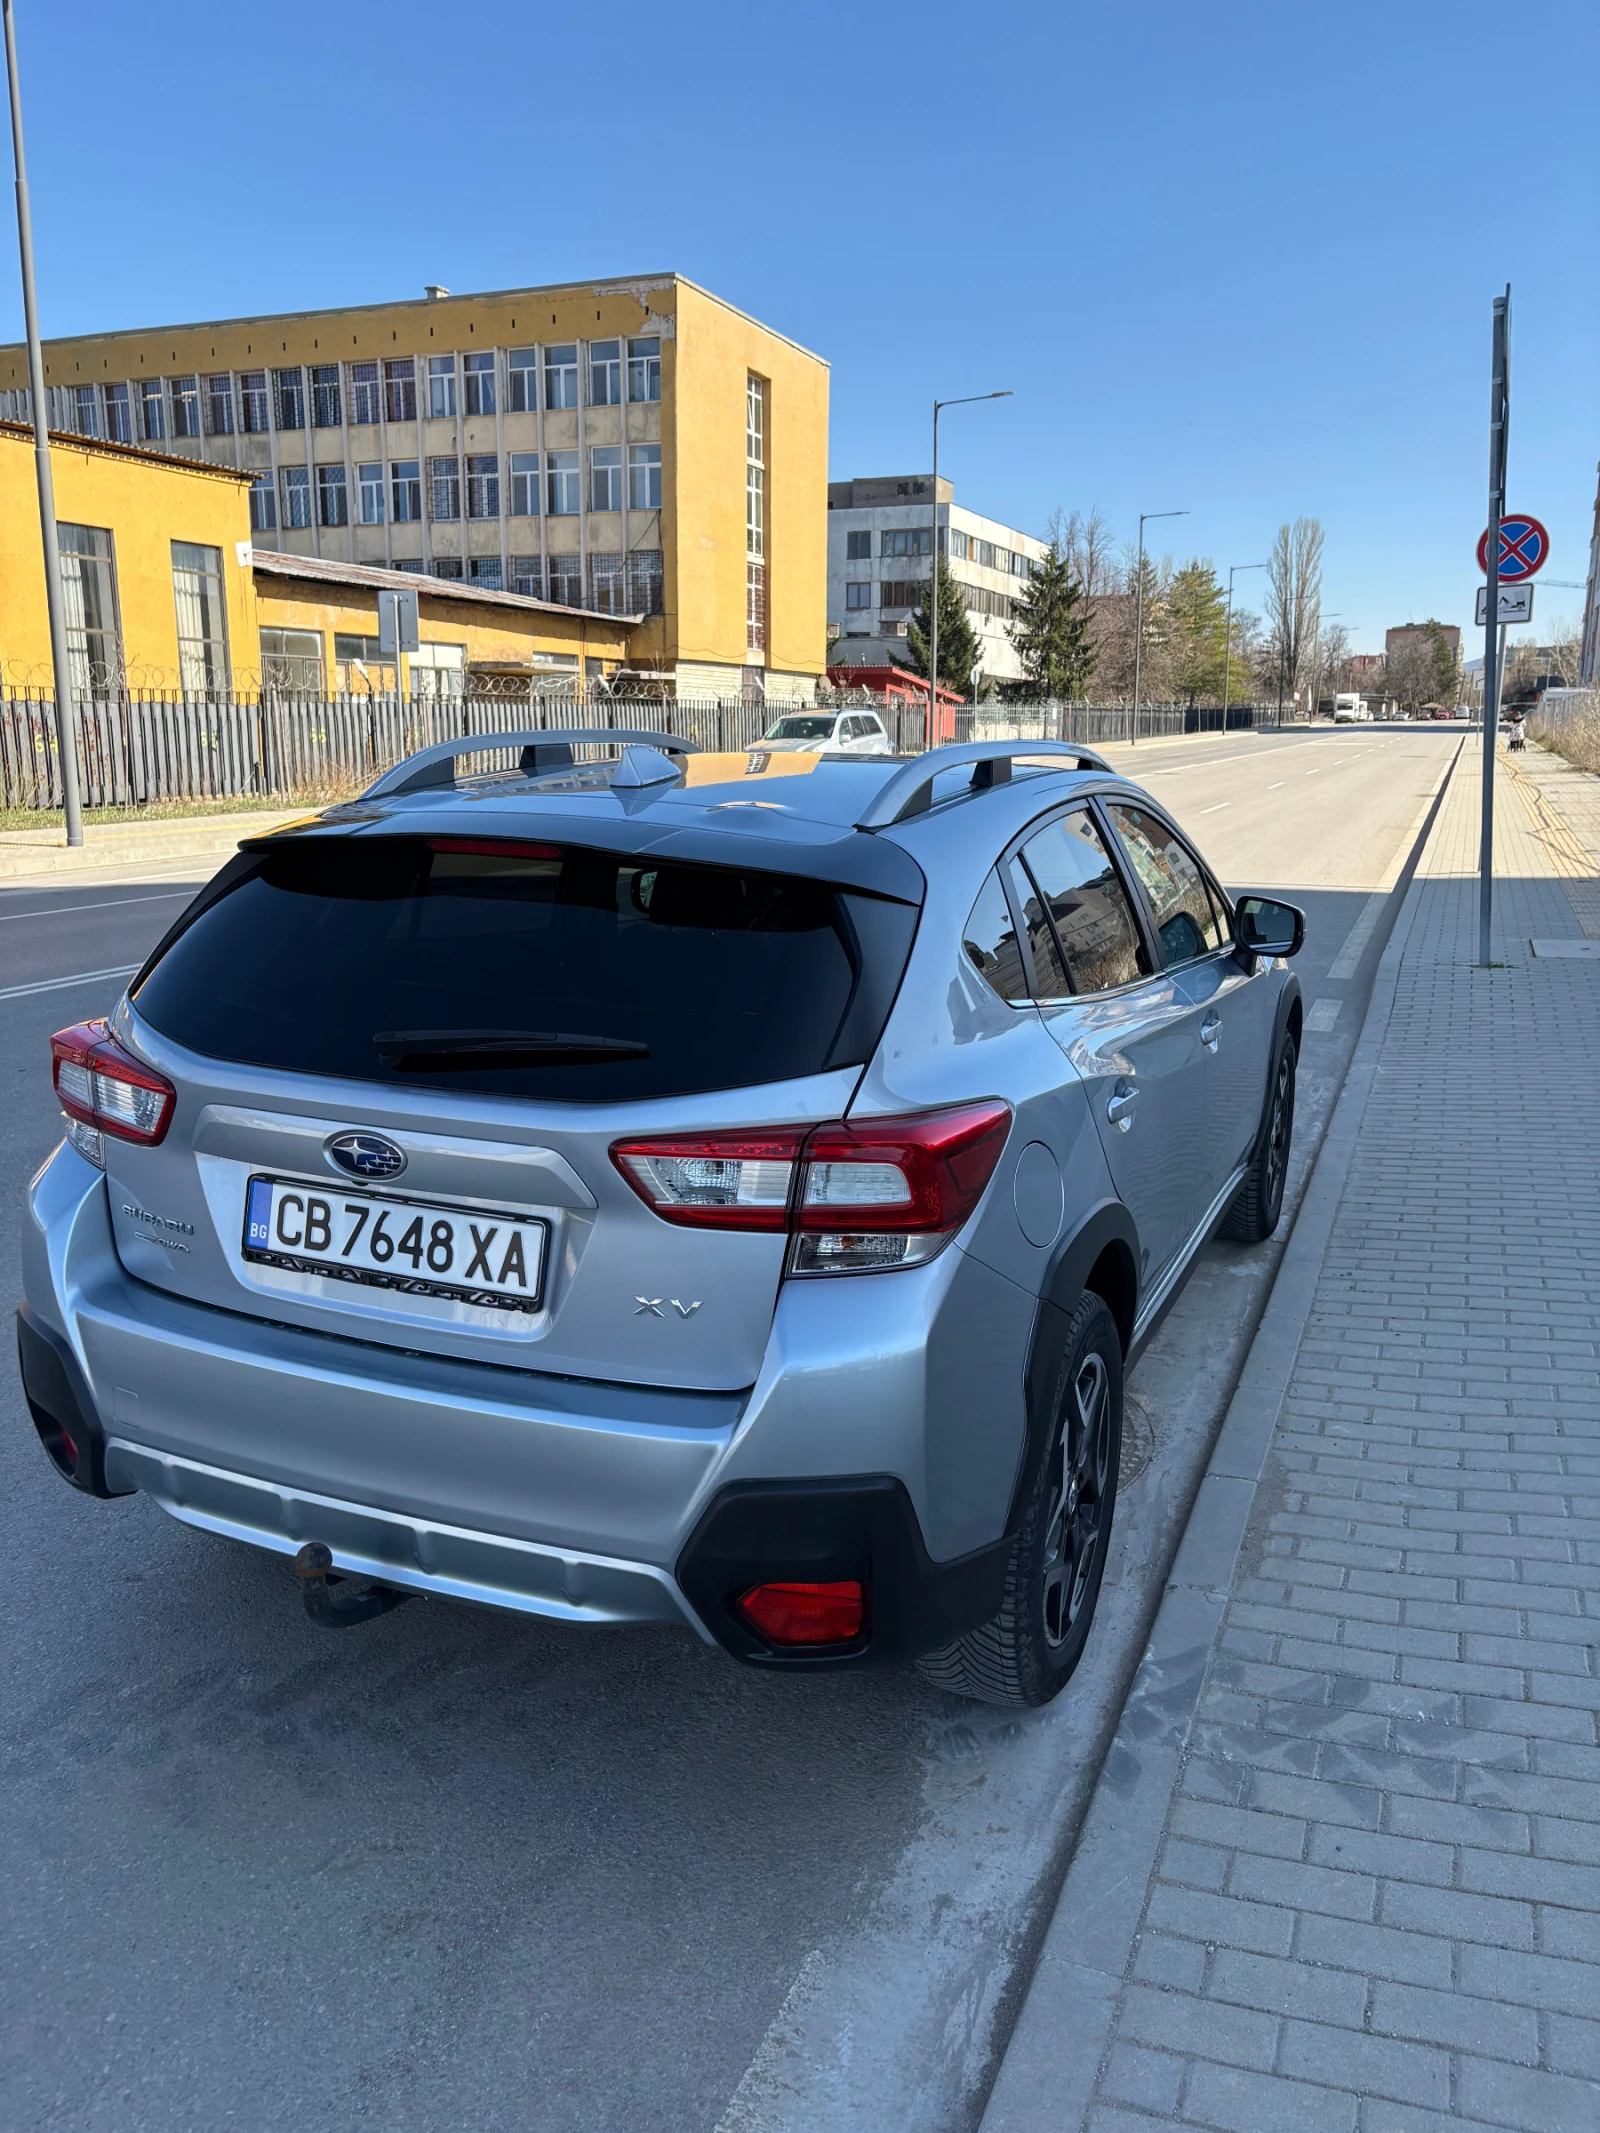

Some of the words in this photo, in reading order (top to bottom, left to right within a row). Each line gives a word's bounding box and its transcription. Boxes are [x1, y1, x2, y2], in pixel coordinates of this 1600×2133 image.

[122, 1204, 194, 1236] SUBARU
[249, 1222, 268, 1240] BG
[277, 1194, 331, 1252] CB
[341, 1204, 454, 1273] 7648
[464, 1224, 527, 1287] XA
[632, 1295, 705, 1320] XV
